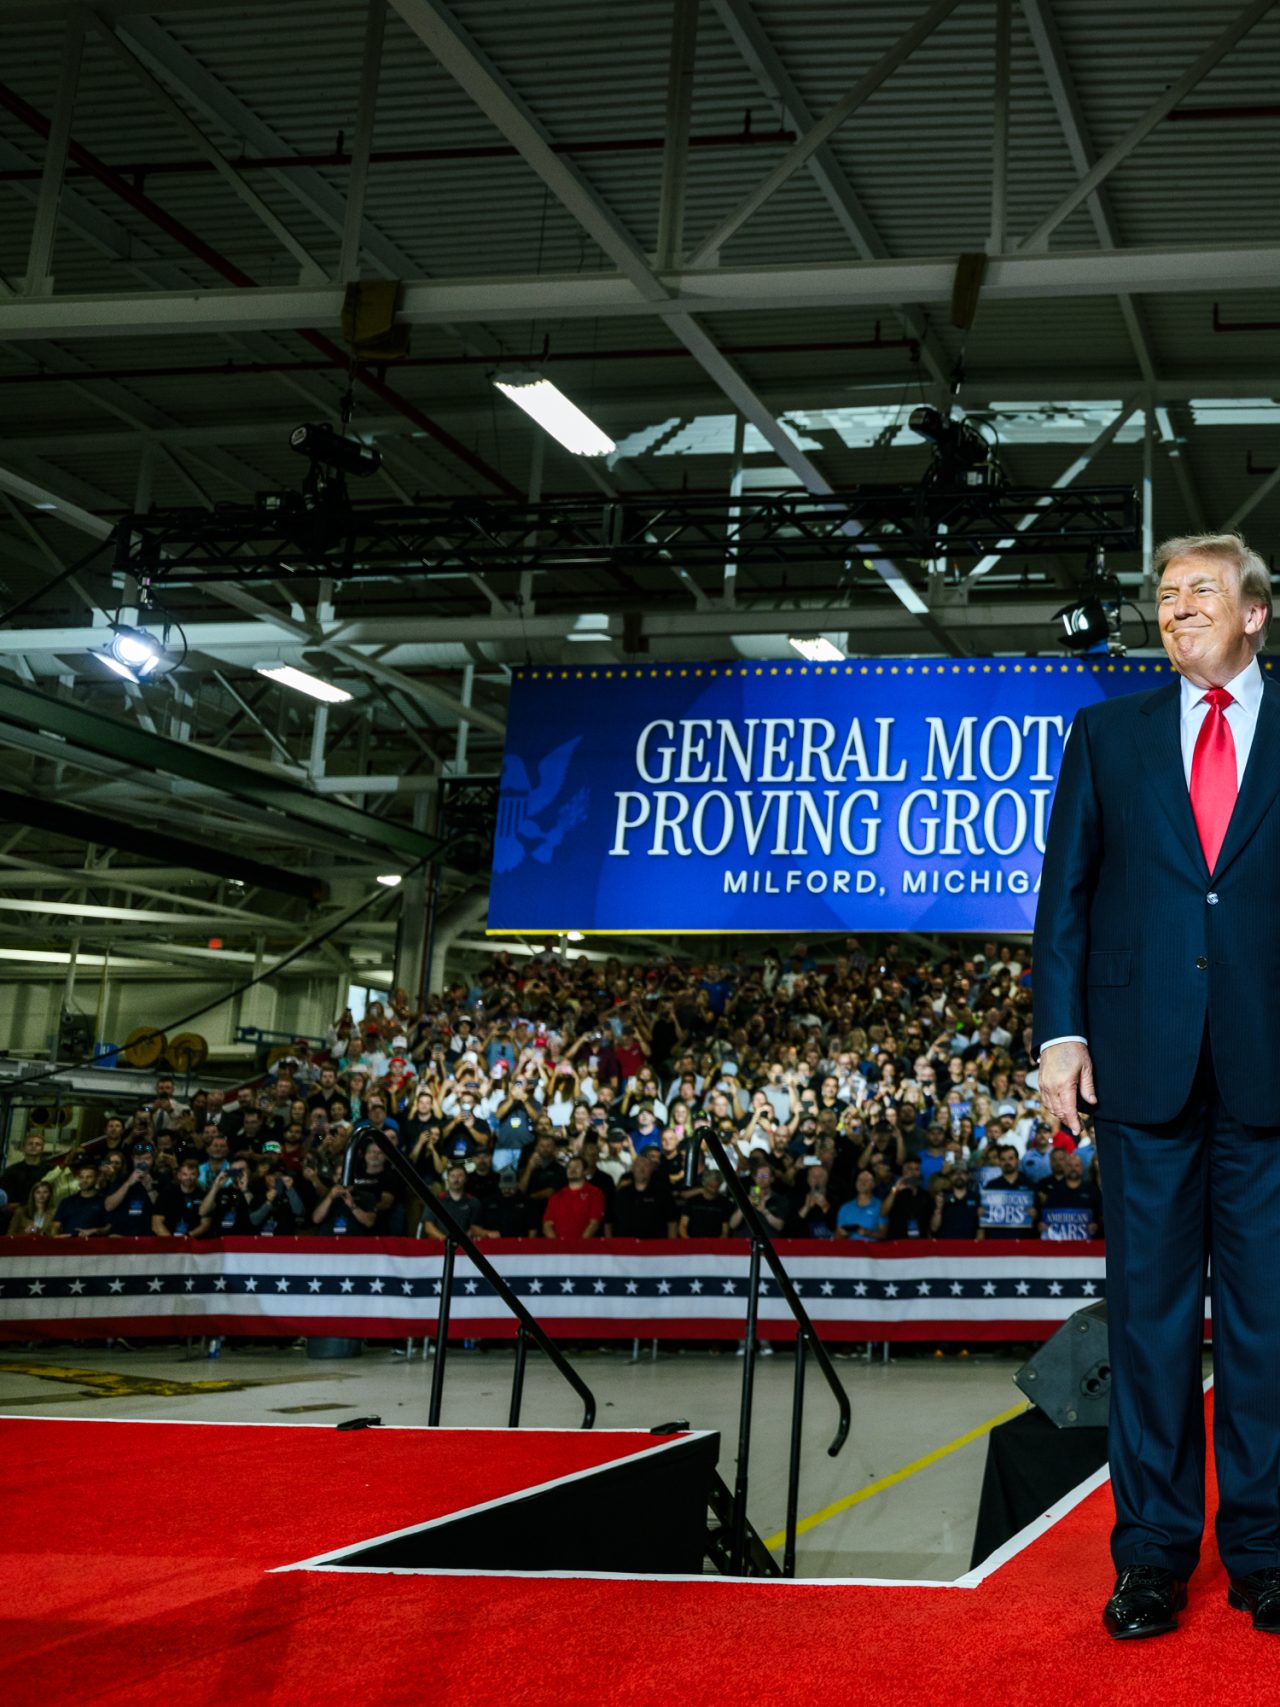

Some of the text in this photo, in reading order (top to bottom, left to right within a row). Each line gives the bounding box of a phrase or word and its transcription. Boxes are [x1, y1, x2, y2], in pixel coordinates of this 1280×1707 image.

[635, 715, 1073, 784] GENERAL MOT
[608, 790, 881, 857] PROVING
[723, 870, 886, 896] MILFORD,
[987, 1205, 1024, 1223] JOBS
[1047, 1222, 1088, 1240] CARS
